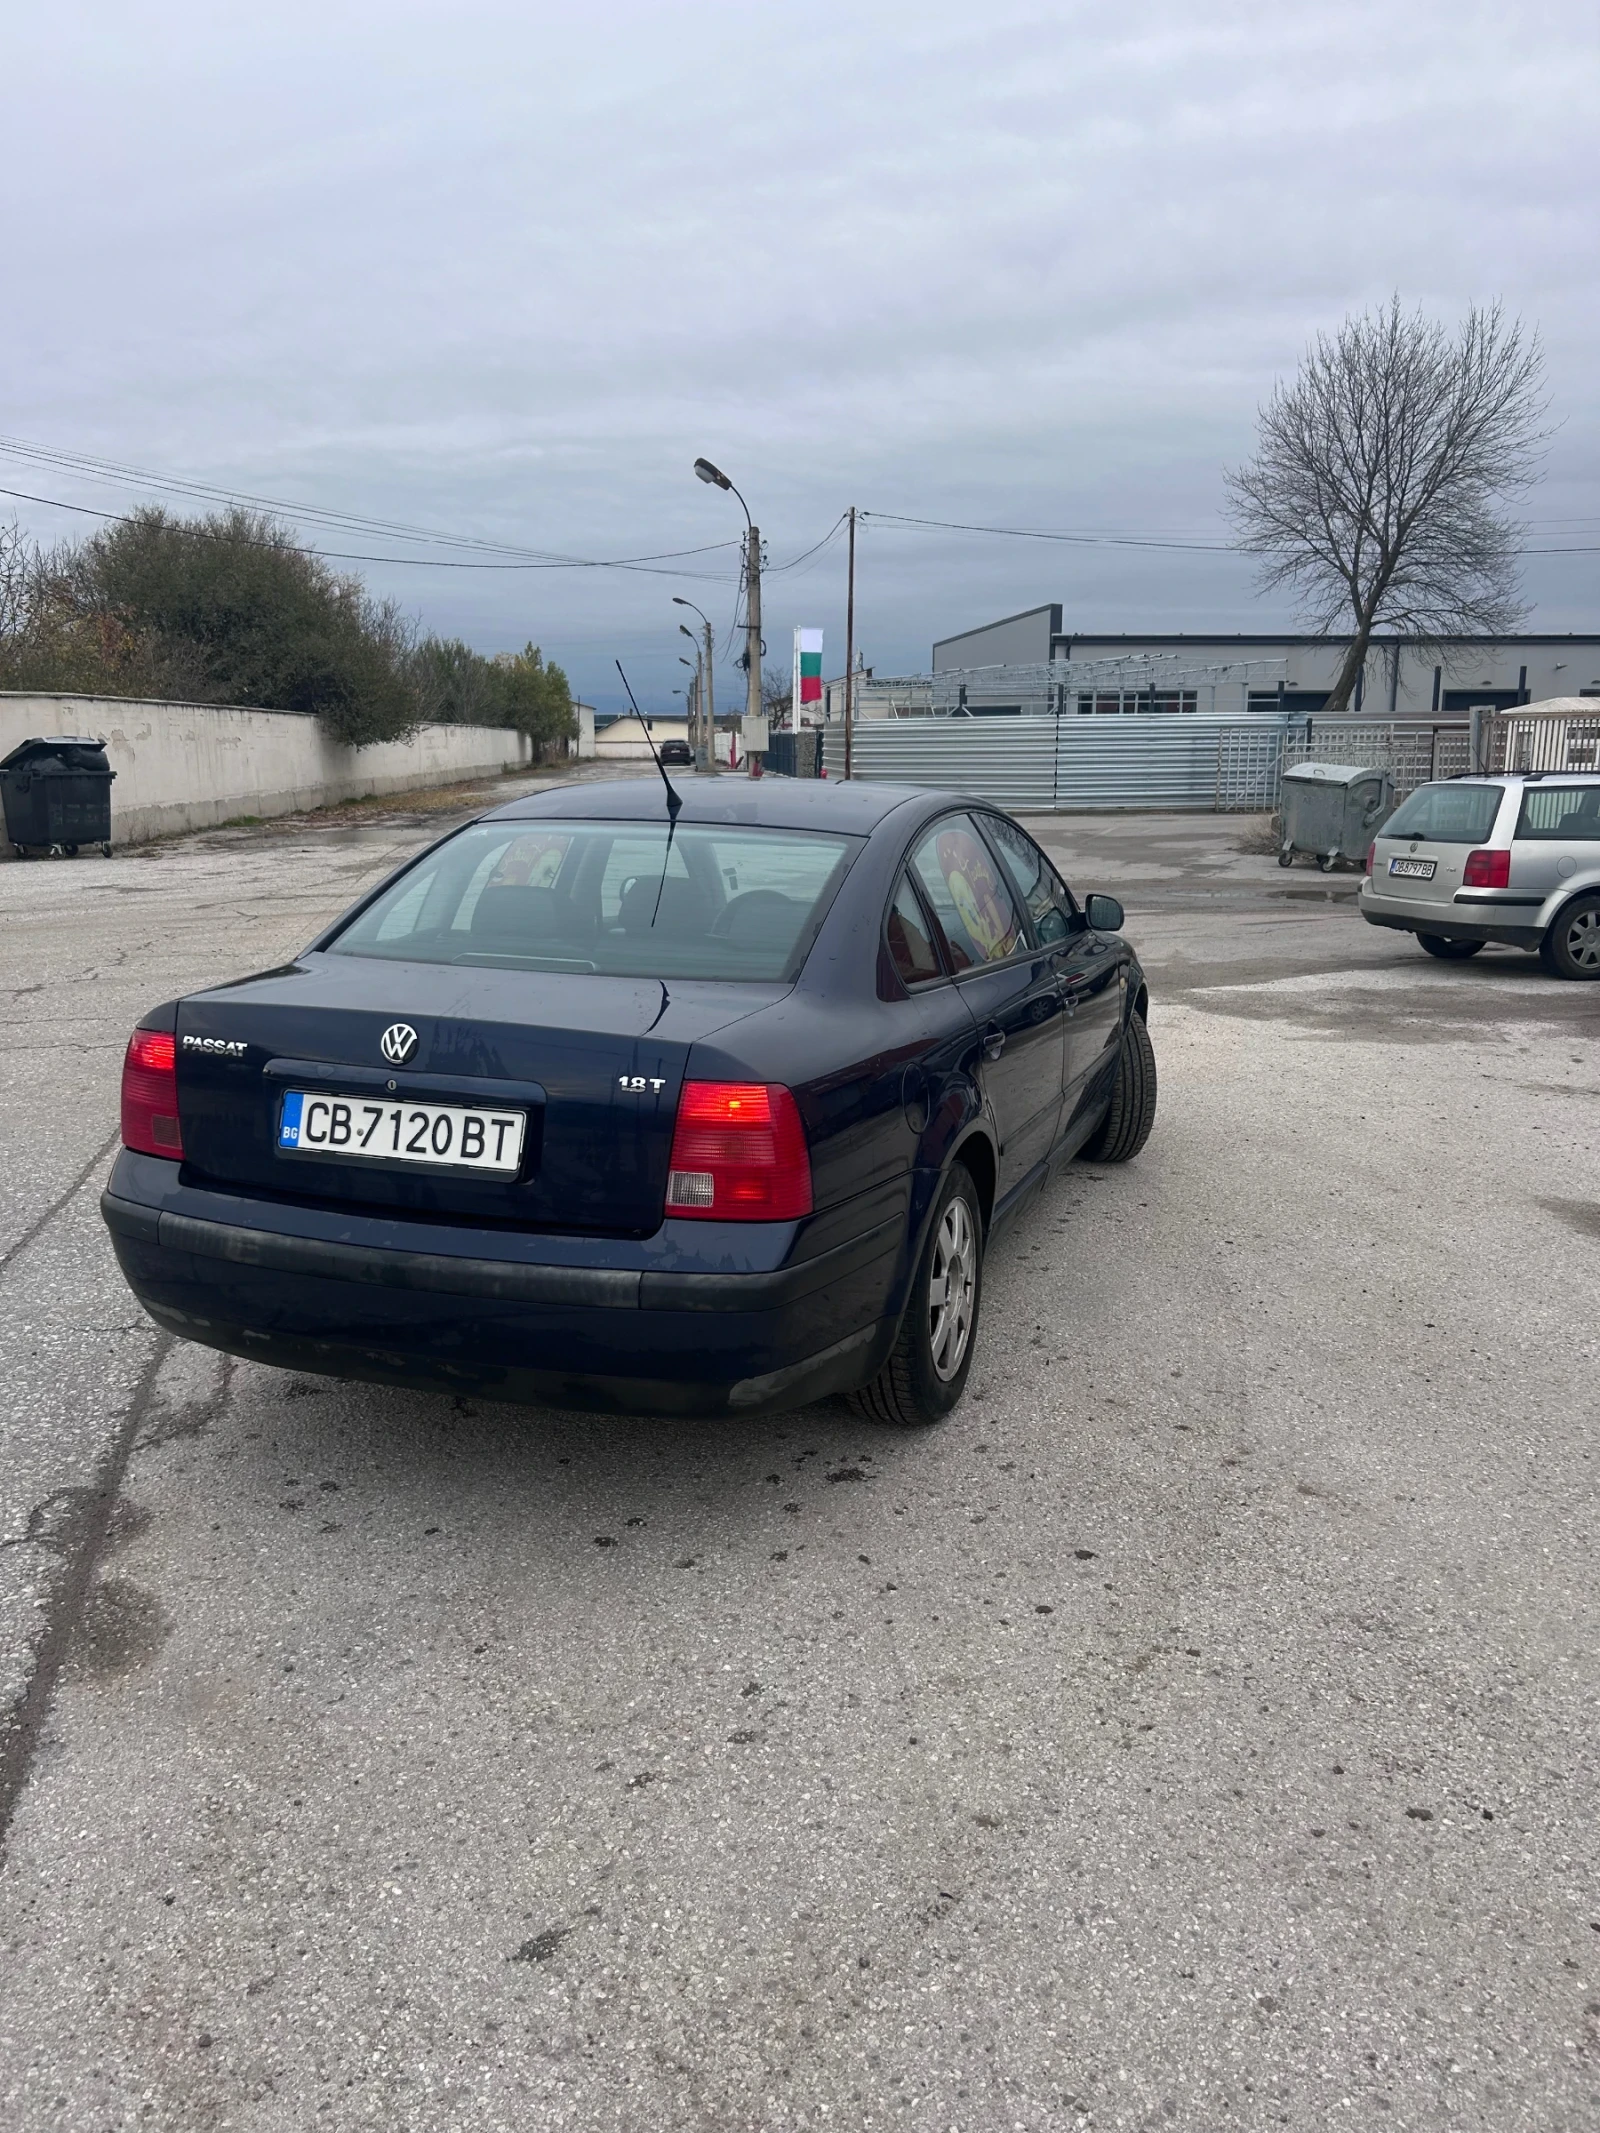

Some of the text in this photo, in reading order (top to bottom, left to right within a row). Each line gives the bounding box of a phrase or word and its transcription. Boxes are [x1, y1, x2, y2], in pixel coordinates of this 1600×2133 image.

[182, 1035, 248, 1057] PASSAT
[282, 1126, 298, 1139] BG
[306, 1102, 515, 1161] CB 7120 BT
